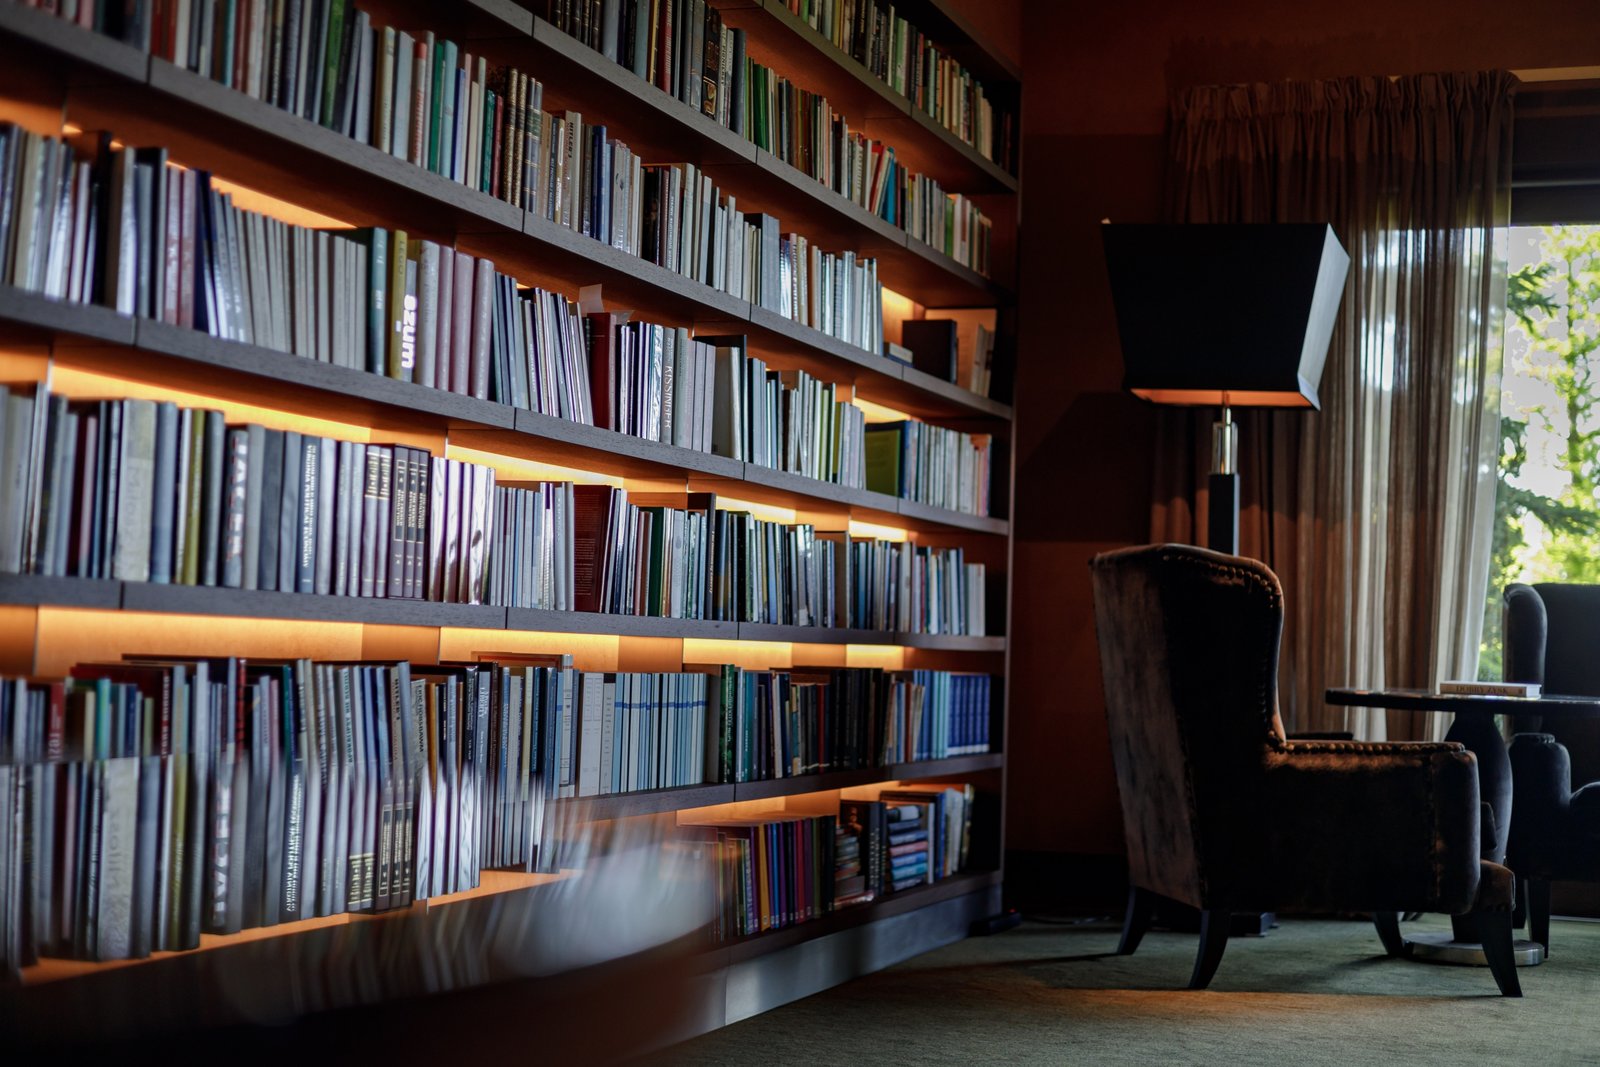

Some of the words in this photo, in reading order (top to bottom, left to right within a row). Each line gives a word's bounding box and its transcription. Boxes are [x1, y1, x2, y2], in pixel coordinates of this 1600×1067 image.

[402, 294, 418, 368] szum
[664, 365, 673, 429] KISSINGER
[304, 444, 312, 482] VIRGINIA
[303, 484, 311, 524] POLITICAL
[302, 527, 311, 567] ECONOMY
